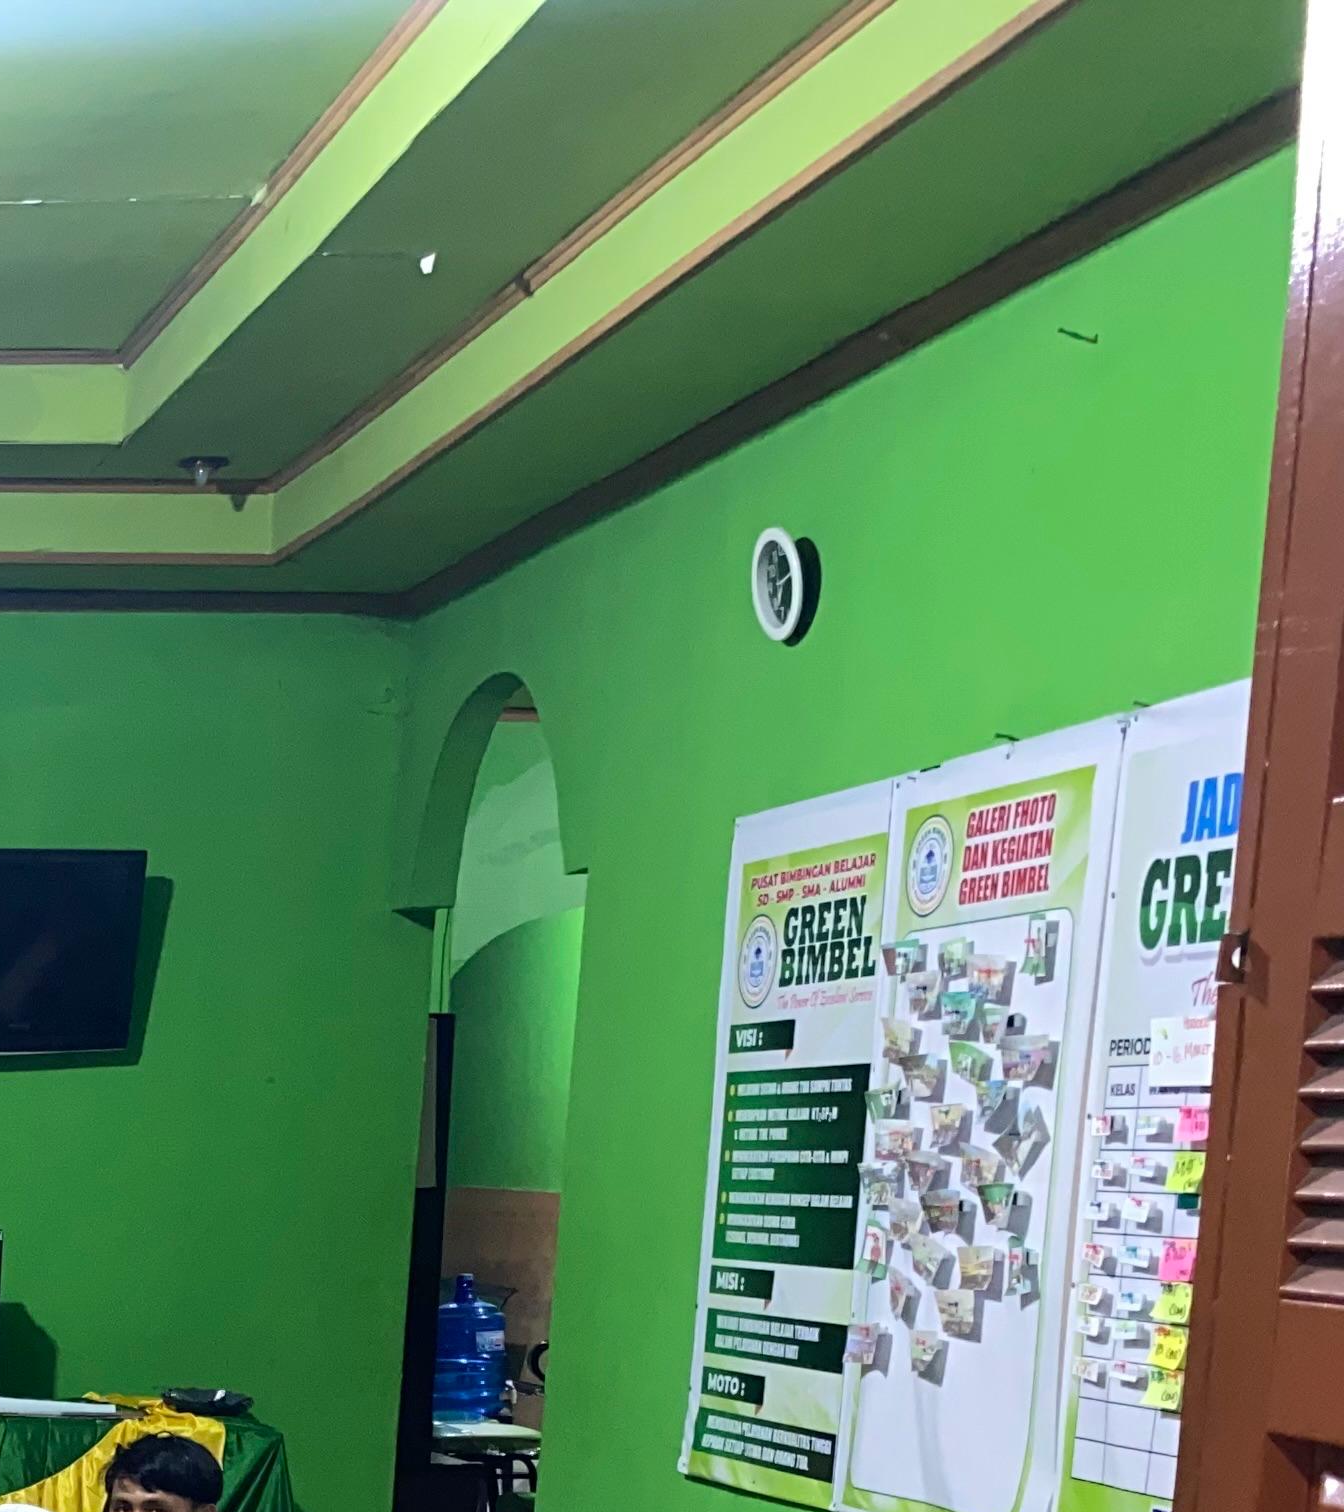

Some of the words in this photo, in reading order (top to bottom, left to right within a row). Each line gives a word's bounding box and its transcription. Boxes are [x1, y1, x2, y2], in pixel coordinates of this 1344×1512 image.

[966, 803, 1012, 839] GALERI
[1180, 772, 1244, 845] JAD
[962, 842, 989, 873] DAN
[990, 827, 1055, 868] KEGIATAN
[751, 873, 779, 890] PUSAT
[780, 861, 832, 885] BIMBINGAN
[834, 853, 877, 874] BELAJAR
[776, 888, 795, 903] SMP
[801, 884, 821, 899] SMA
[829, 875, 867, 893] ALUMNI
[958, 873, 1000, 905] GREEN
[1001, 863, 1050, 898] BIMBEL
[1139, 848, 1234, 951] GRE
[783, 894, 867, 948] GREEN
[778, 936, 876, 988] BIMBEL
[735, 1029, 757, 1048] VISI
[1110, 1083, 1136, 1096] KELAS
[716, 1271, 739, 1290] MISI
[707, 1373, 740, 1396] MOTO
